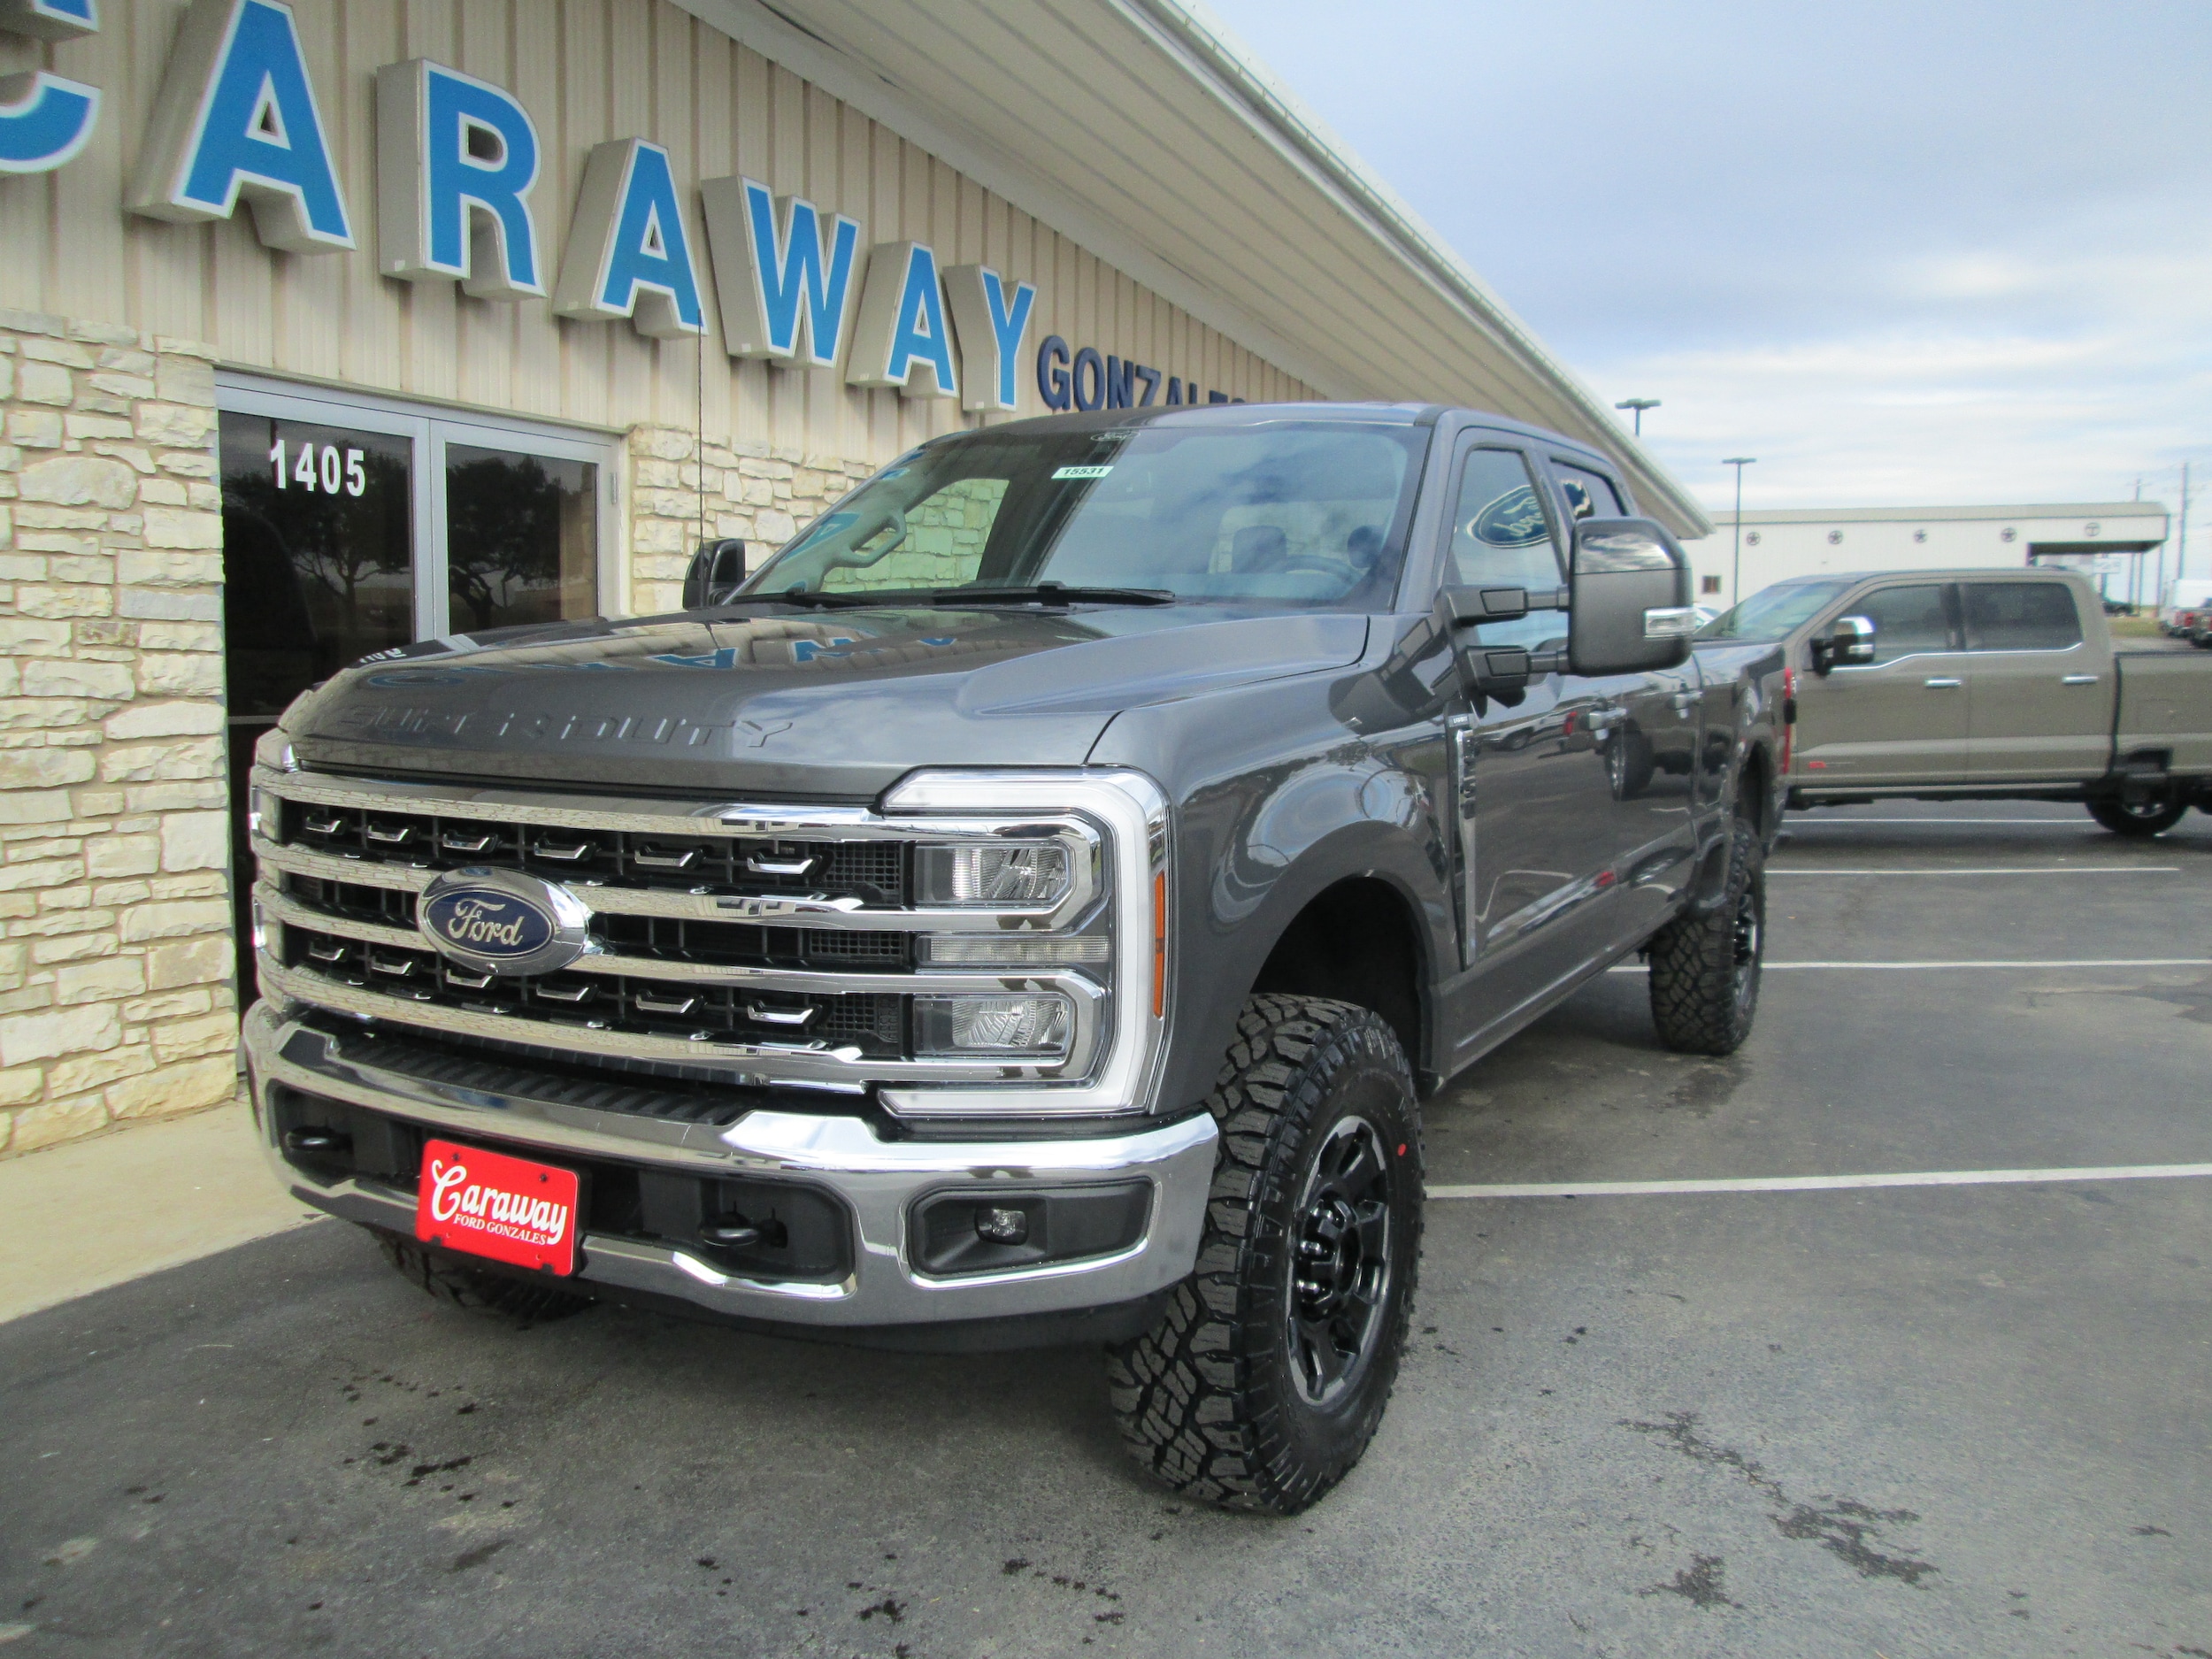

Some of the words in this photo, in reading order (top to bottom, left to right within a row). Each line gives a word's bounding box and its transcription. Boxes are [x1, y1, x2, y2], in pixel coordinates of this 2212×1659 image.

[1037, 335, 1246, 411] GONZA
[270, 439, 366, 497] 1405
[1064, 467, 1105, 476] 15531
[560, 715, 794, 748] DUTY
[448, 897, 525, 947] Ford
[431, 1159, 568, 1246] Caraway
[453, 1213, 486, 1231] FORD
[487, 1221, 548, 1246] GONZALES
